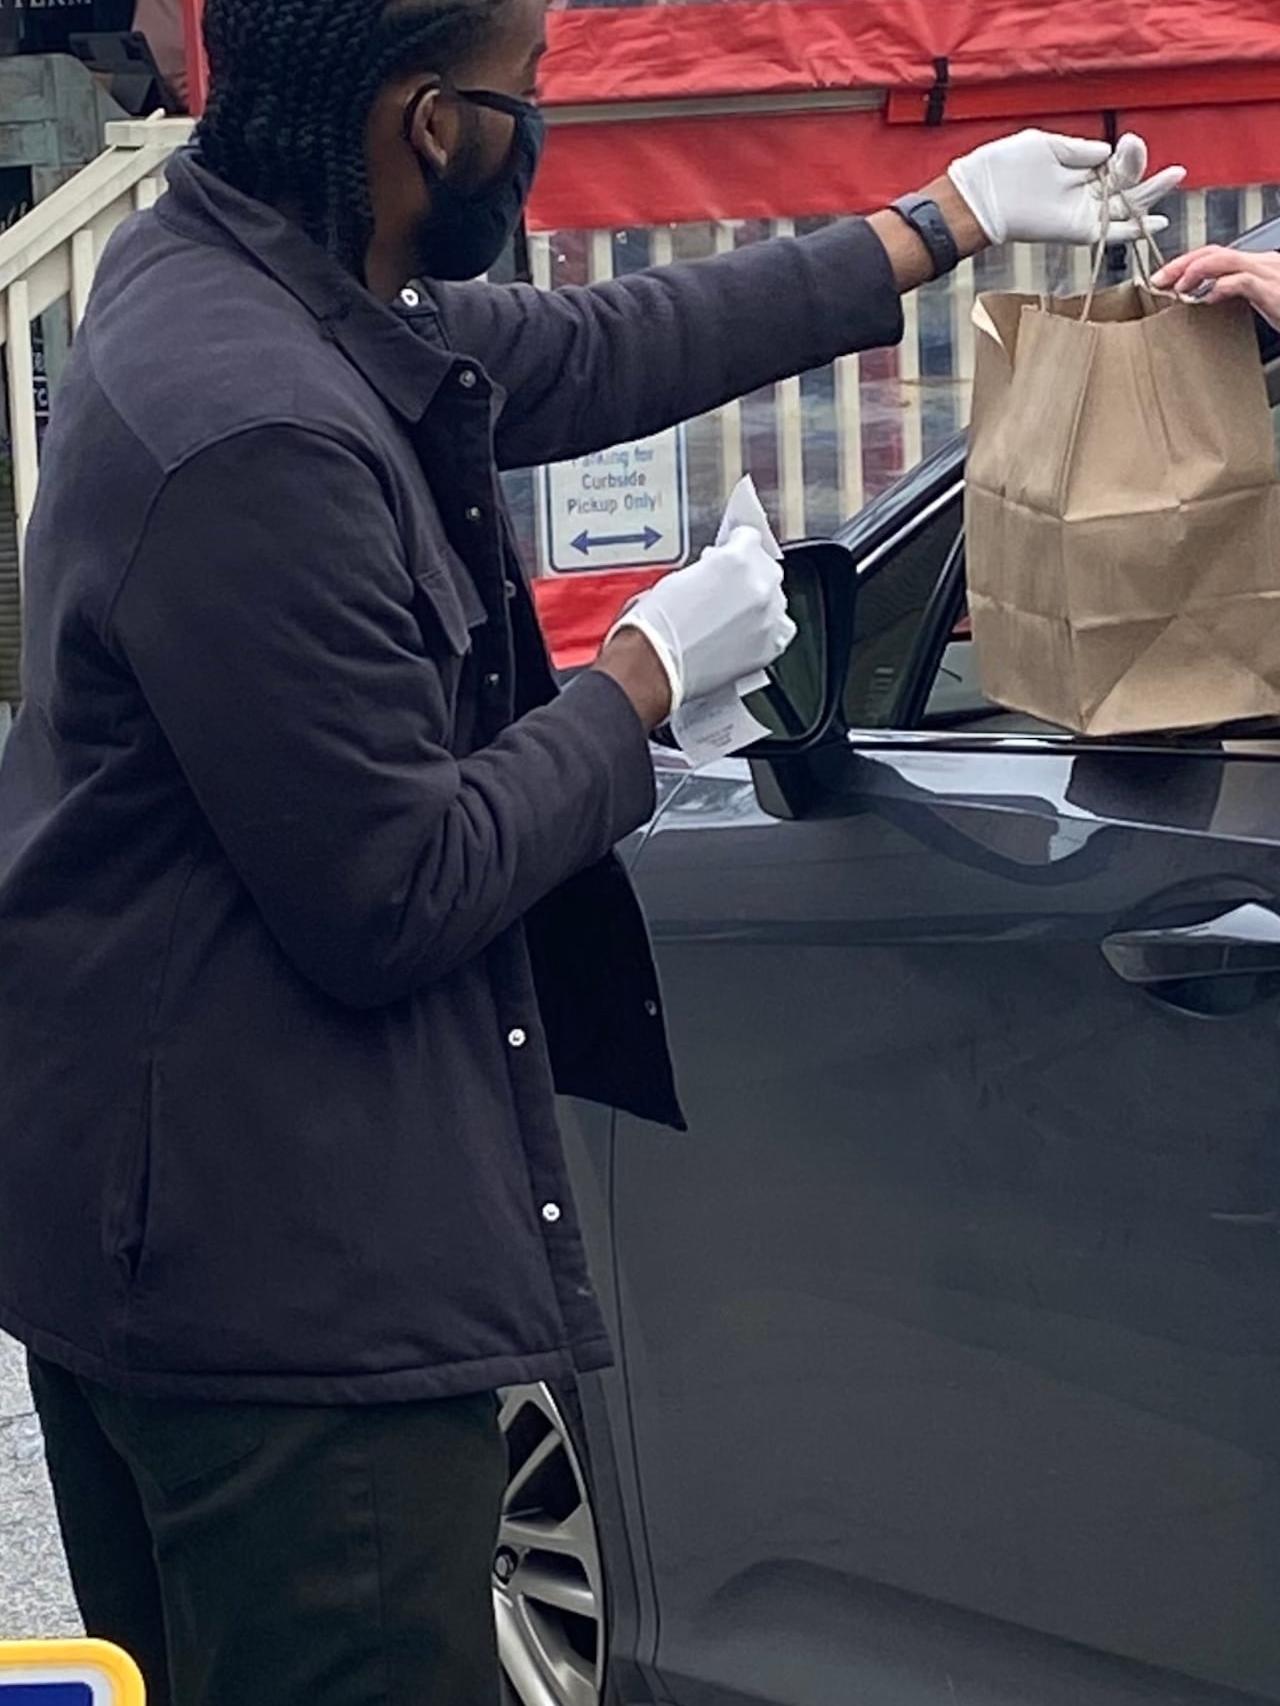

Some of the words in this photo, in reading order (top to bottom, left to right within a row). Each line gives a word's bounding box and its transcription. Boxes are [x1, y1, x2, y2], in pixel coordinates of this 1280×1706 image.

[635, 446, 654, 462] for
[582, 470, 647, 490] Curbside
[567, 496, 618, 516] Pickup
